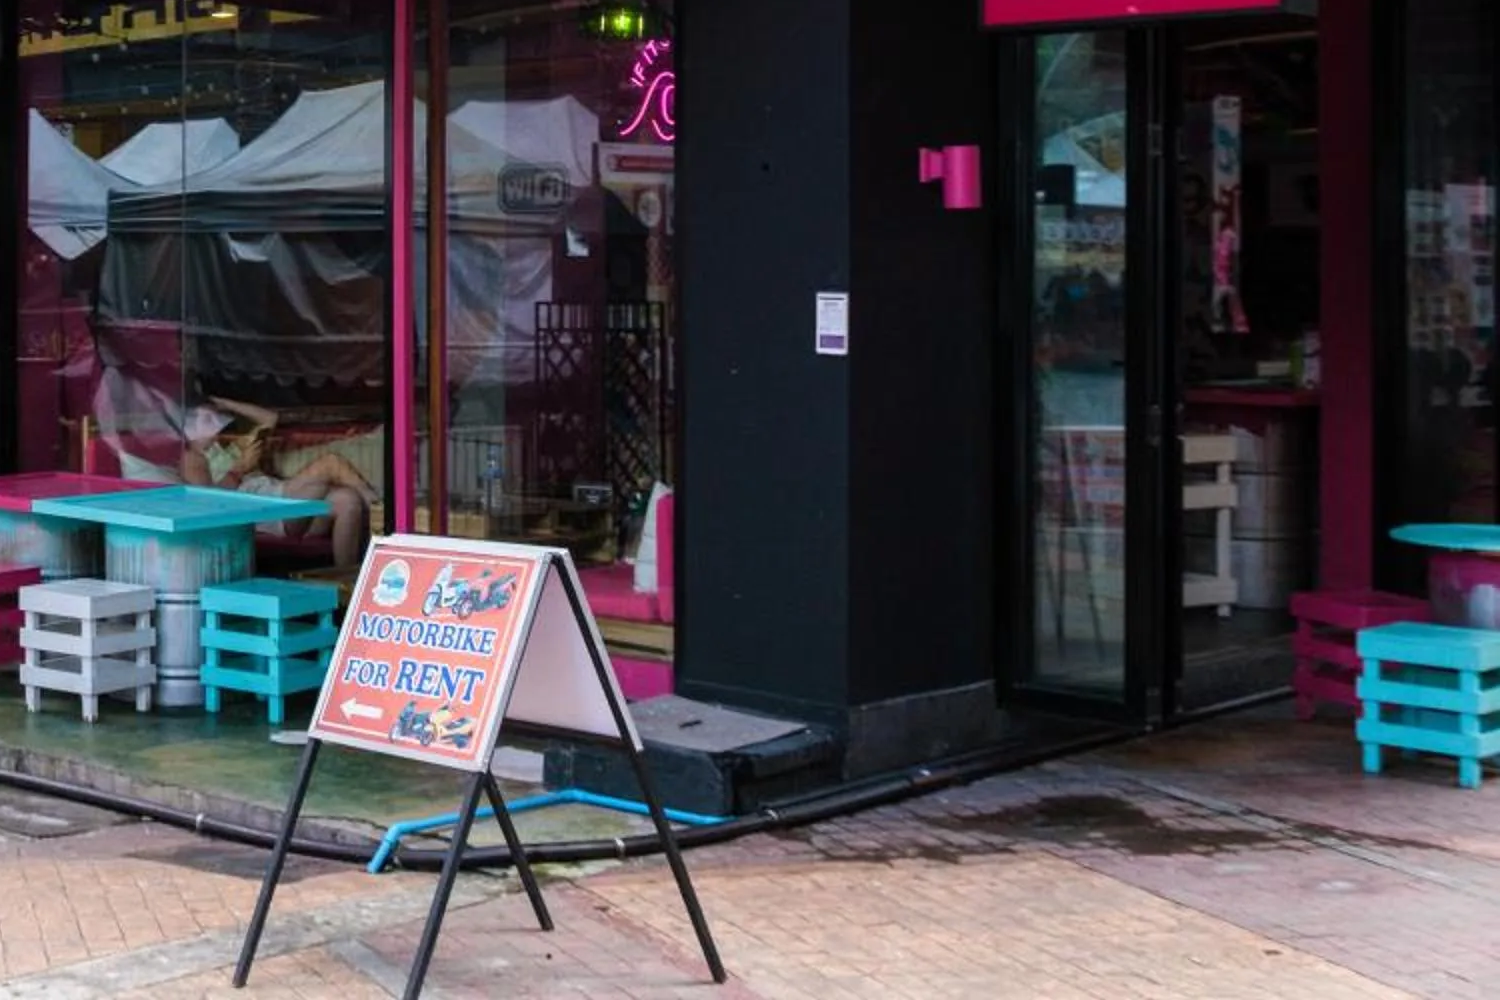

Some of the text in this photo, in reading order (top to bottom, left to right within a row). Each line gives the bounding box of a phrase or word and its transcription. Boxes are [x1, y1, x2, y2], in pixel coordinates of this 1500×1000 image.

[357, 612, 497, 655] MOTORBIKE
[344, 657, 486, 702] FOR RENT
